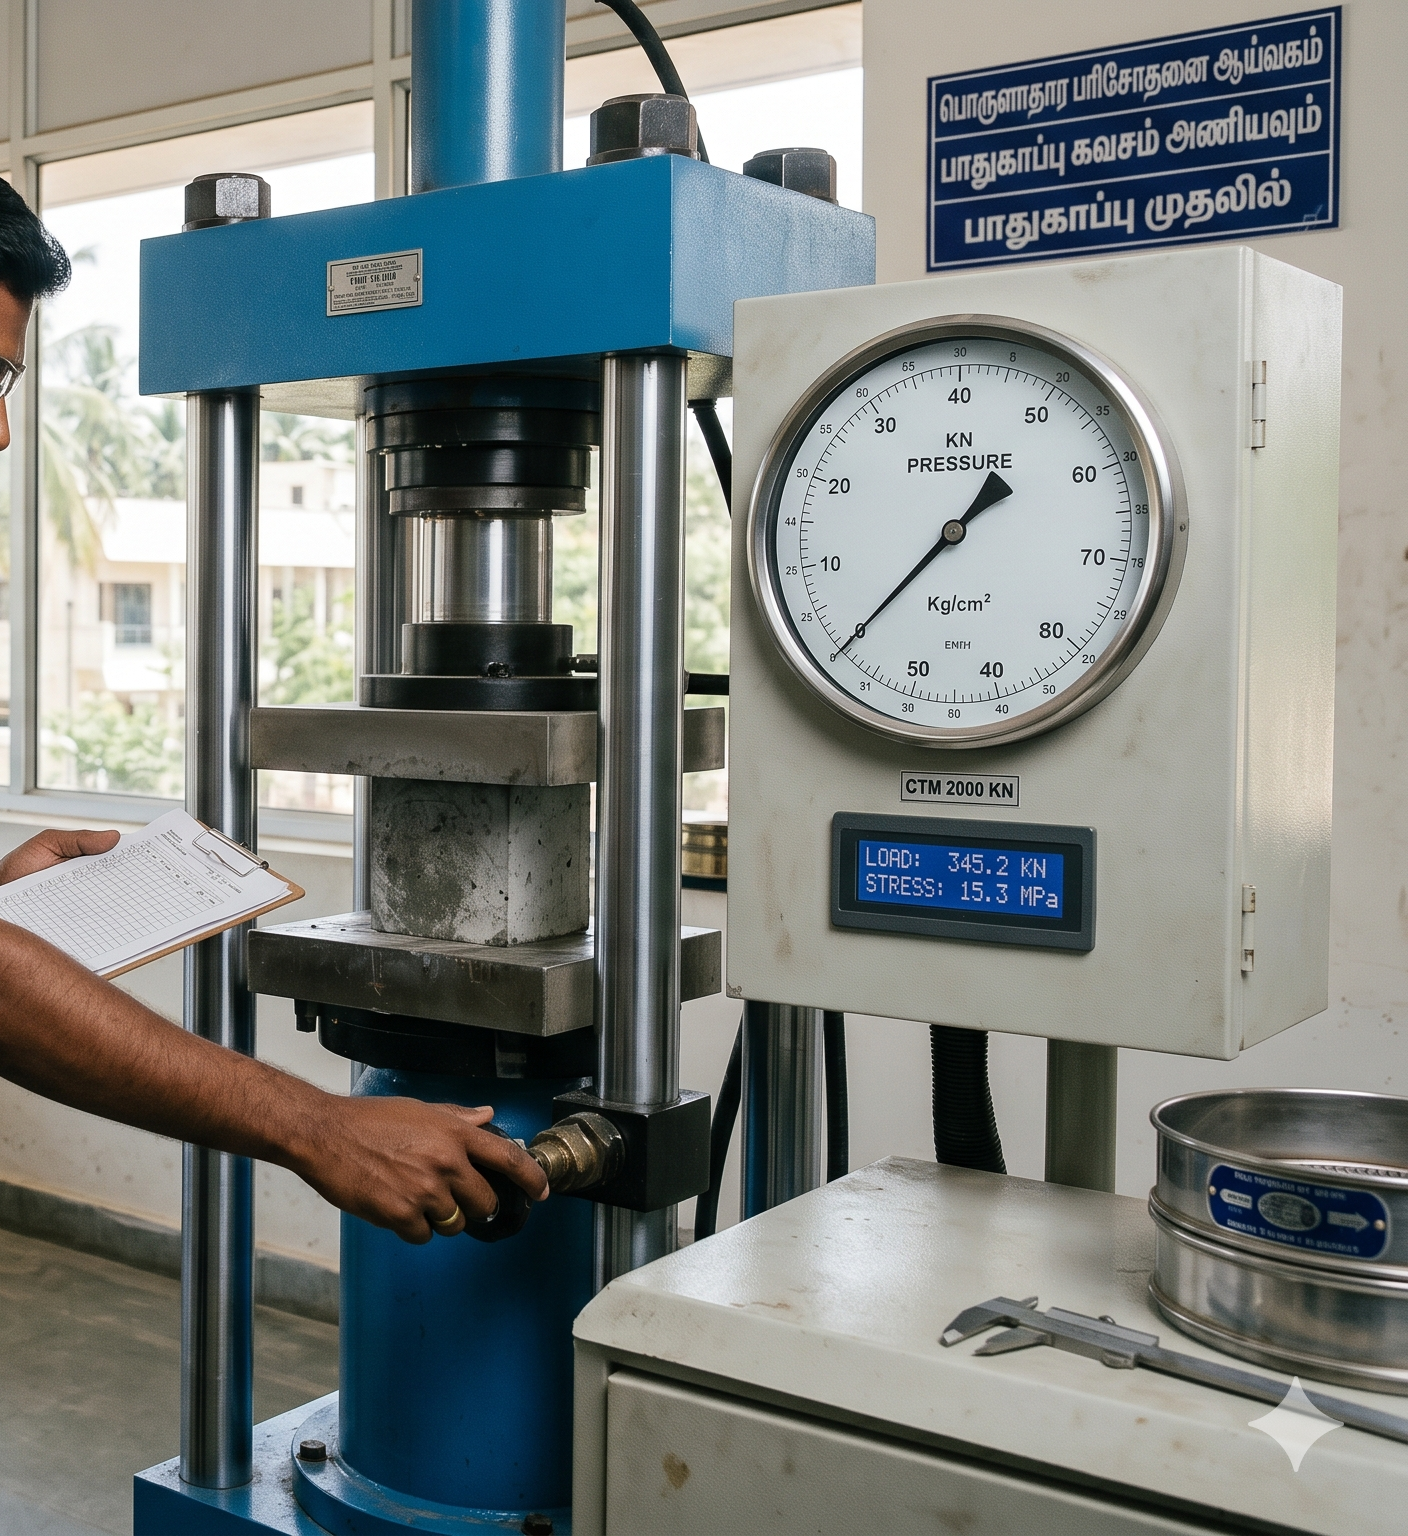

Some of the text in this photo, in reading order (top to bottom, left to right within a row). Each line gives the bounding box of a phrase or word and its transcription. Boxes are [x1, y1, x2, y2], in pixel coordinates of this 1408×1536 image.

[939, 25, 1323, 125] பொருளாதார பரிசோதனை ஆய்வகம்
[940, 92, 1323, 191] பாதுகாப்பு கவசம் அணியவும்
[964, 168, 1292, 250] பாதுகாப்பு முதலில்
[953, 346, 967, 358] 30
[1055, 371, 1070, 383] 20
[947, 387, 971, 405] 40
[1024, 406, 1049, 424] 50
[1095, 404, 1110, 416] 35
[819, 423, 833, 435] 55
[874, 416, 897, 434] 30
[946, 431, 973, 449] KN
[907, 452, 1013, 475] PRESSURE
[1122, 450, 1137, 462] 30
[1072, 465, 1097, 484] 60
[828, 477, 851, 495] 20
[1135, 503, 1148, 515] 35
[784, 516, 797, 527] 44
[820, 555, 841, 572] 10
[1080, 548, 1106, 566] 70
[1131, 557, 1144, 569] 78
[785, 565, 798, 576] 25
[800, 612, 814, 623] 25
[1113, 609, 1127, 621] 29
[855, 622, 866, 639] 0
[1039, 621, 1064, 639] 80
[1082, 654, 1096, 665] 20
[907, 660, 930, 677] 50
[979, 661, 1004, 679] 40
[859, 681, 872, 692] 31
[1042, 684, 1056, 695] 50
[994, 703, 1009, 715] 40
[905, 778, 1014, 799] CTM 2000 KN
[865, 847, 1047, 879] LOAD: 345.2 KN
[865, 874, 1059, 909] STRESS: 15.3 MPa
